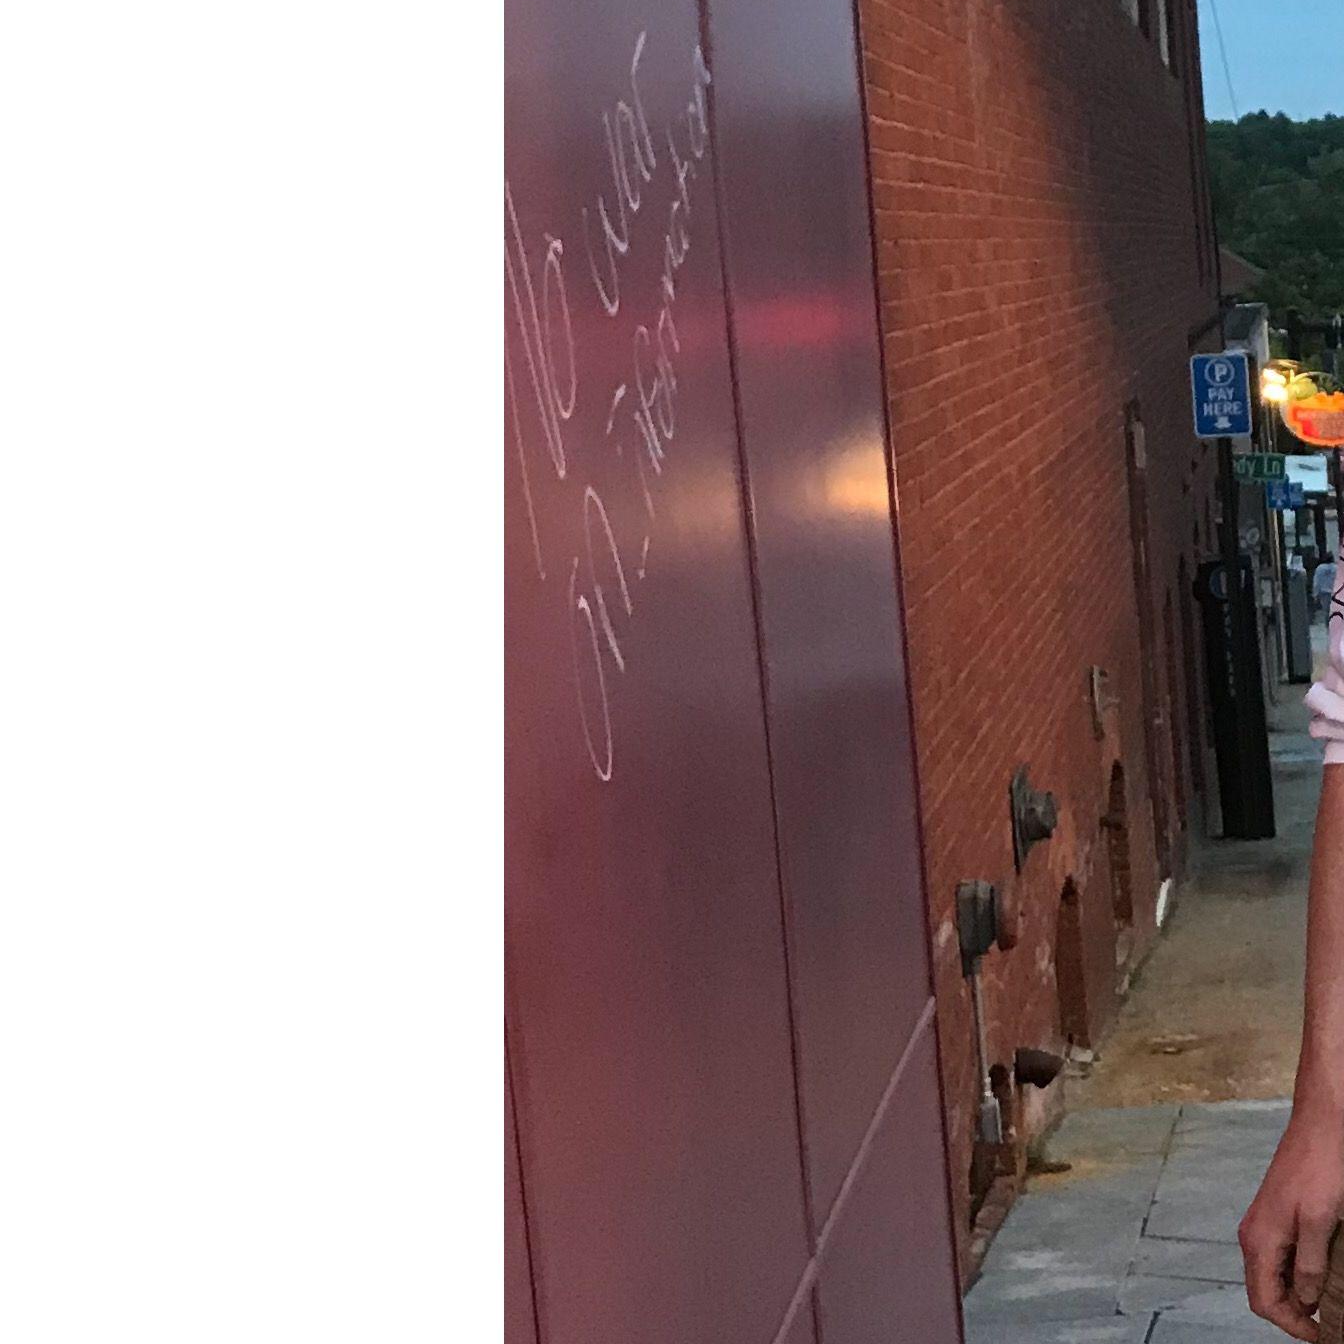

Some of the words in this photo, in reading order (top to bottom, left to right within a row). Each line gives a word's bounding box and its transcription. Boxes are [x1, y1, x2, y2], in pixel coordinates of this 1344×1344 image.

[1208, 387, 1235, 402] PAY
[1203, 401, 1243, 417] HERE
[1262, 455, 1282, 476] Ln
